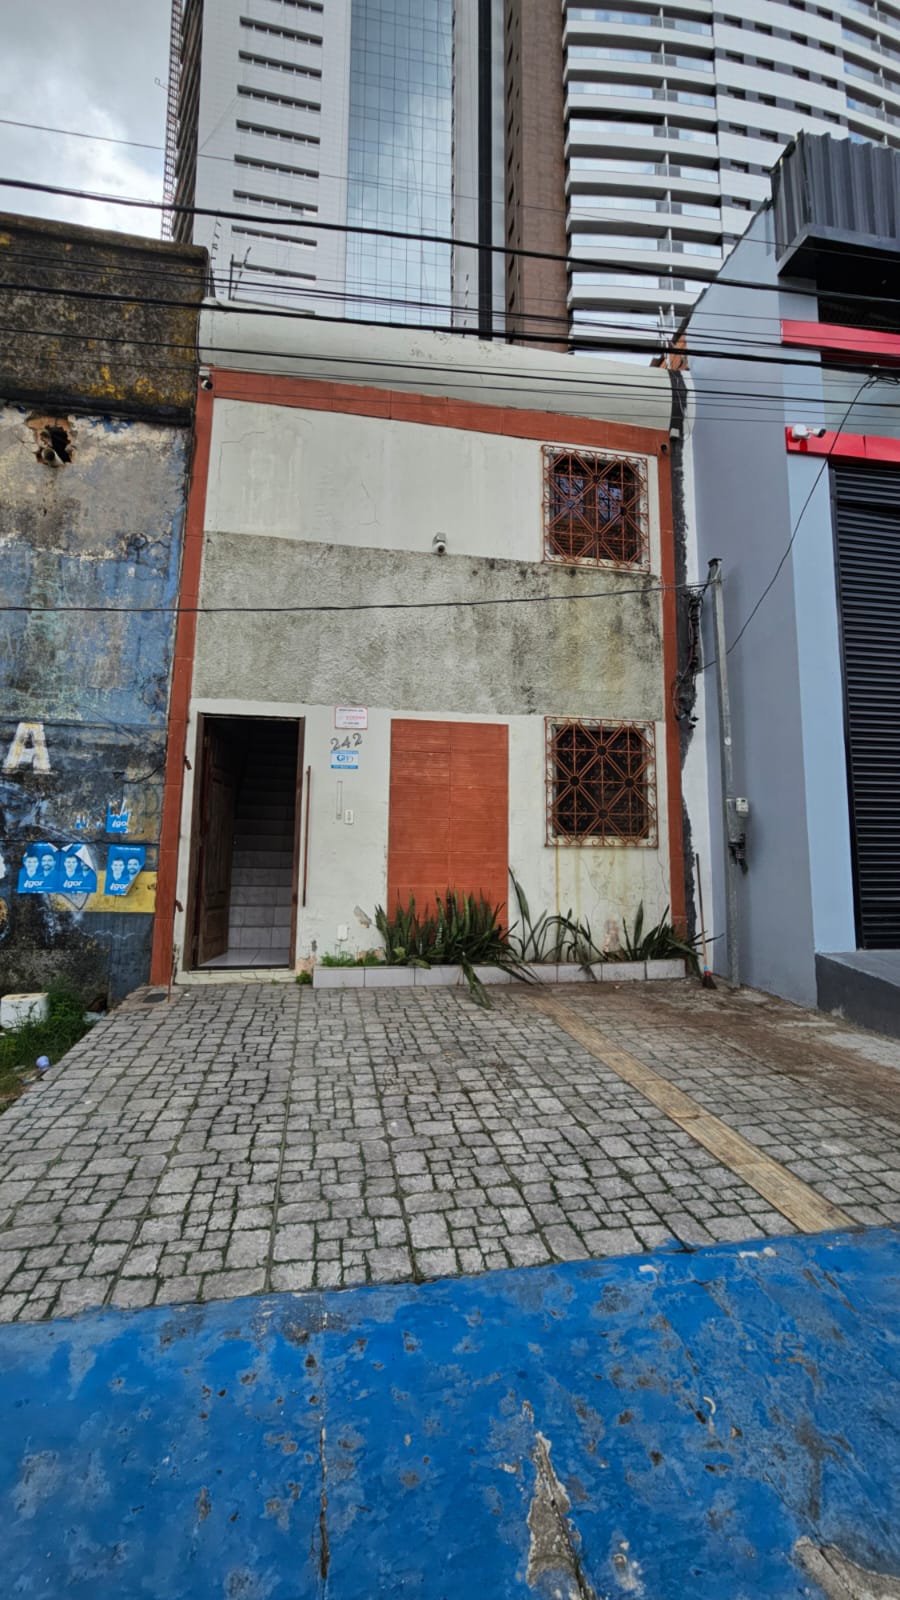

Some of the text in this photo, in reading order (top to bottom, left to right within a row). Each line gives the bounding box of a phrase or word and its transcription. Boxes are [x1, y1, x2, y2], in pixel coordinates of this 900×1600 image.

[3, 722, 51, 774] A
[330, 733, 363, 751] 242
[24, 880, 44, 888] Igor
[63, 880, 83, 888] Igor
